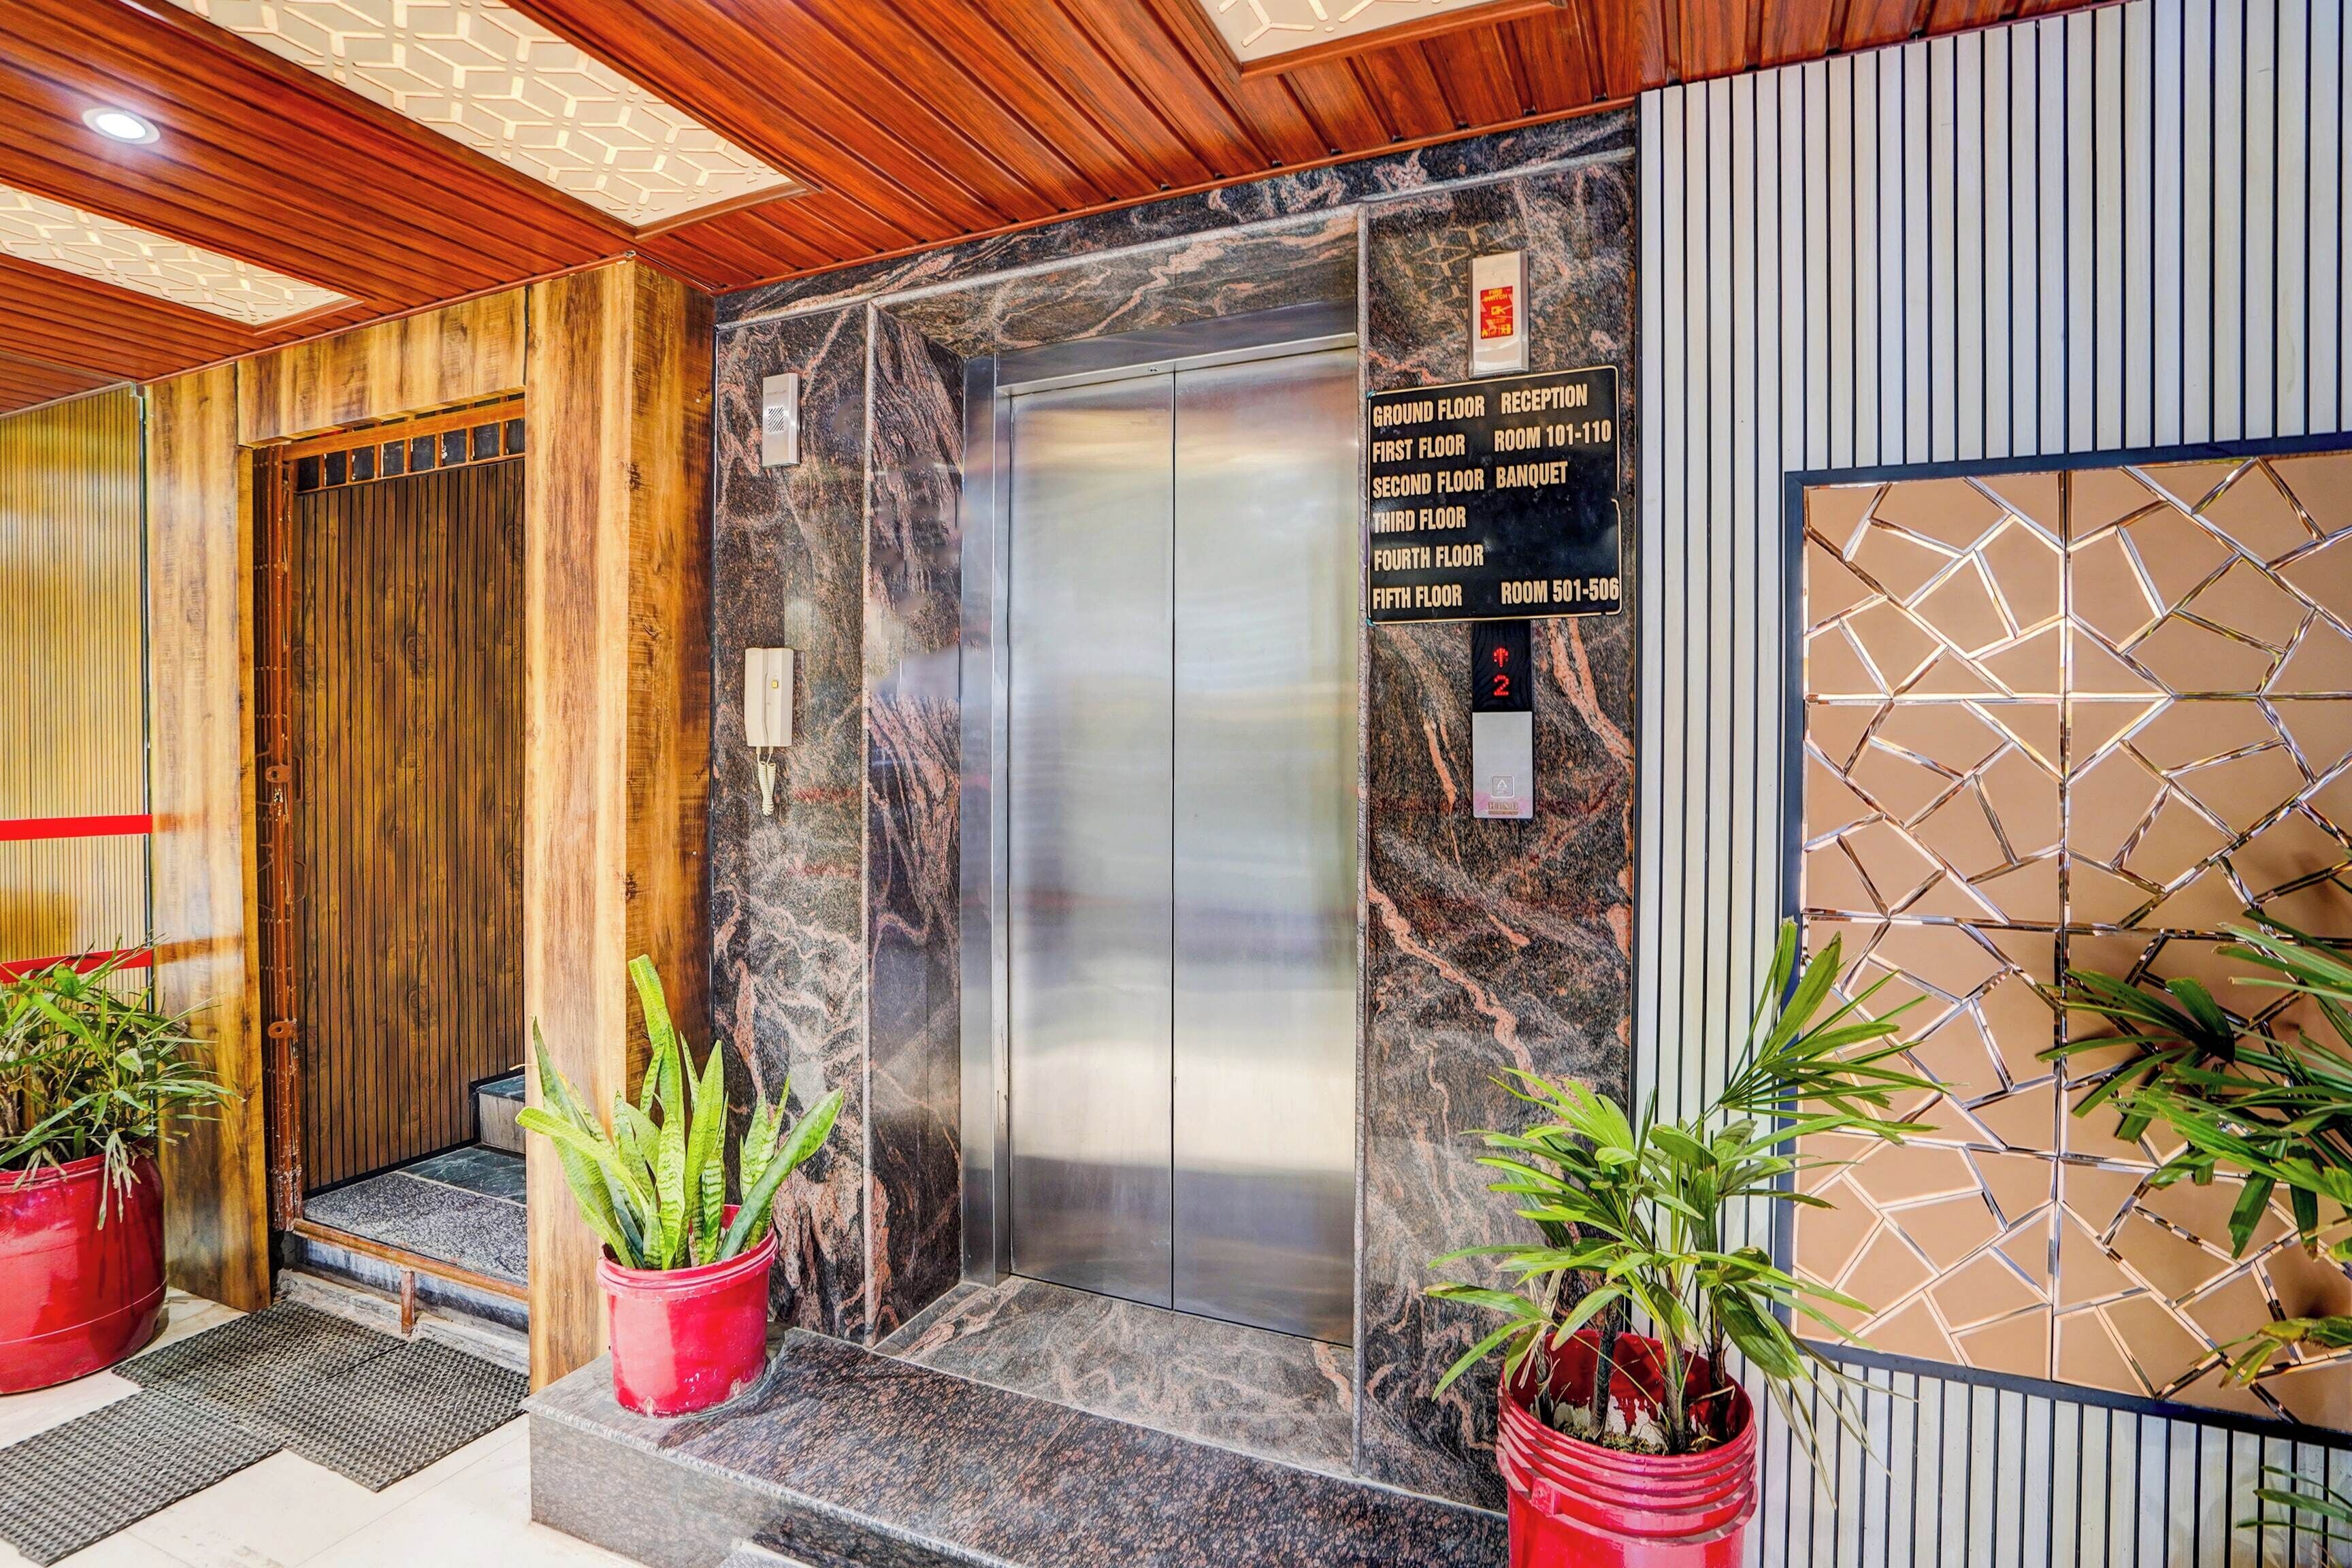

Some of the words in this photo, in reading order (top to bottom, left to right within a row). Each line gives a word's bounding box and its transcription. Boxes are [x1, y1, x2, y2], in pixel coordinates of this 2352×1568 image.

[1373, 401, 1433, 428] GROUND
[1437, 395, 1485, 421] FLOOR
[1501, 383, 1588, 414] RECEPTION
[1373, 439, 1413, 463] FIRST
[1419, 434, 1465, 459] FLOOR
[1494, 427, 1541, 452] ROOM
[1546, 421, 1612, 447] 101-110
[1373, 474, 1431, 499] SECOND
[1437, 468, 1484, 493] FLOOR
[1496, 461, 1568, 490] BANQUET
[1372, 510, 1415, 533] THIRD
[1420, 506, 1466, 531] FLOOR
[1374, 546, 1431, 571] FOURTH
[1436, 544, 1484, 568] FLOOR
[1373, 587, 1411, 610] FIFTH
[1416, 585, 1462, 608] FLOOR
[1501, 581, 1548, 604] ROOM
[1553, 578, 1619, 602] 501-506
[1493, 674, 1509, 696] 2
